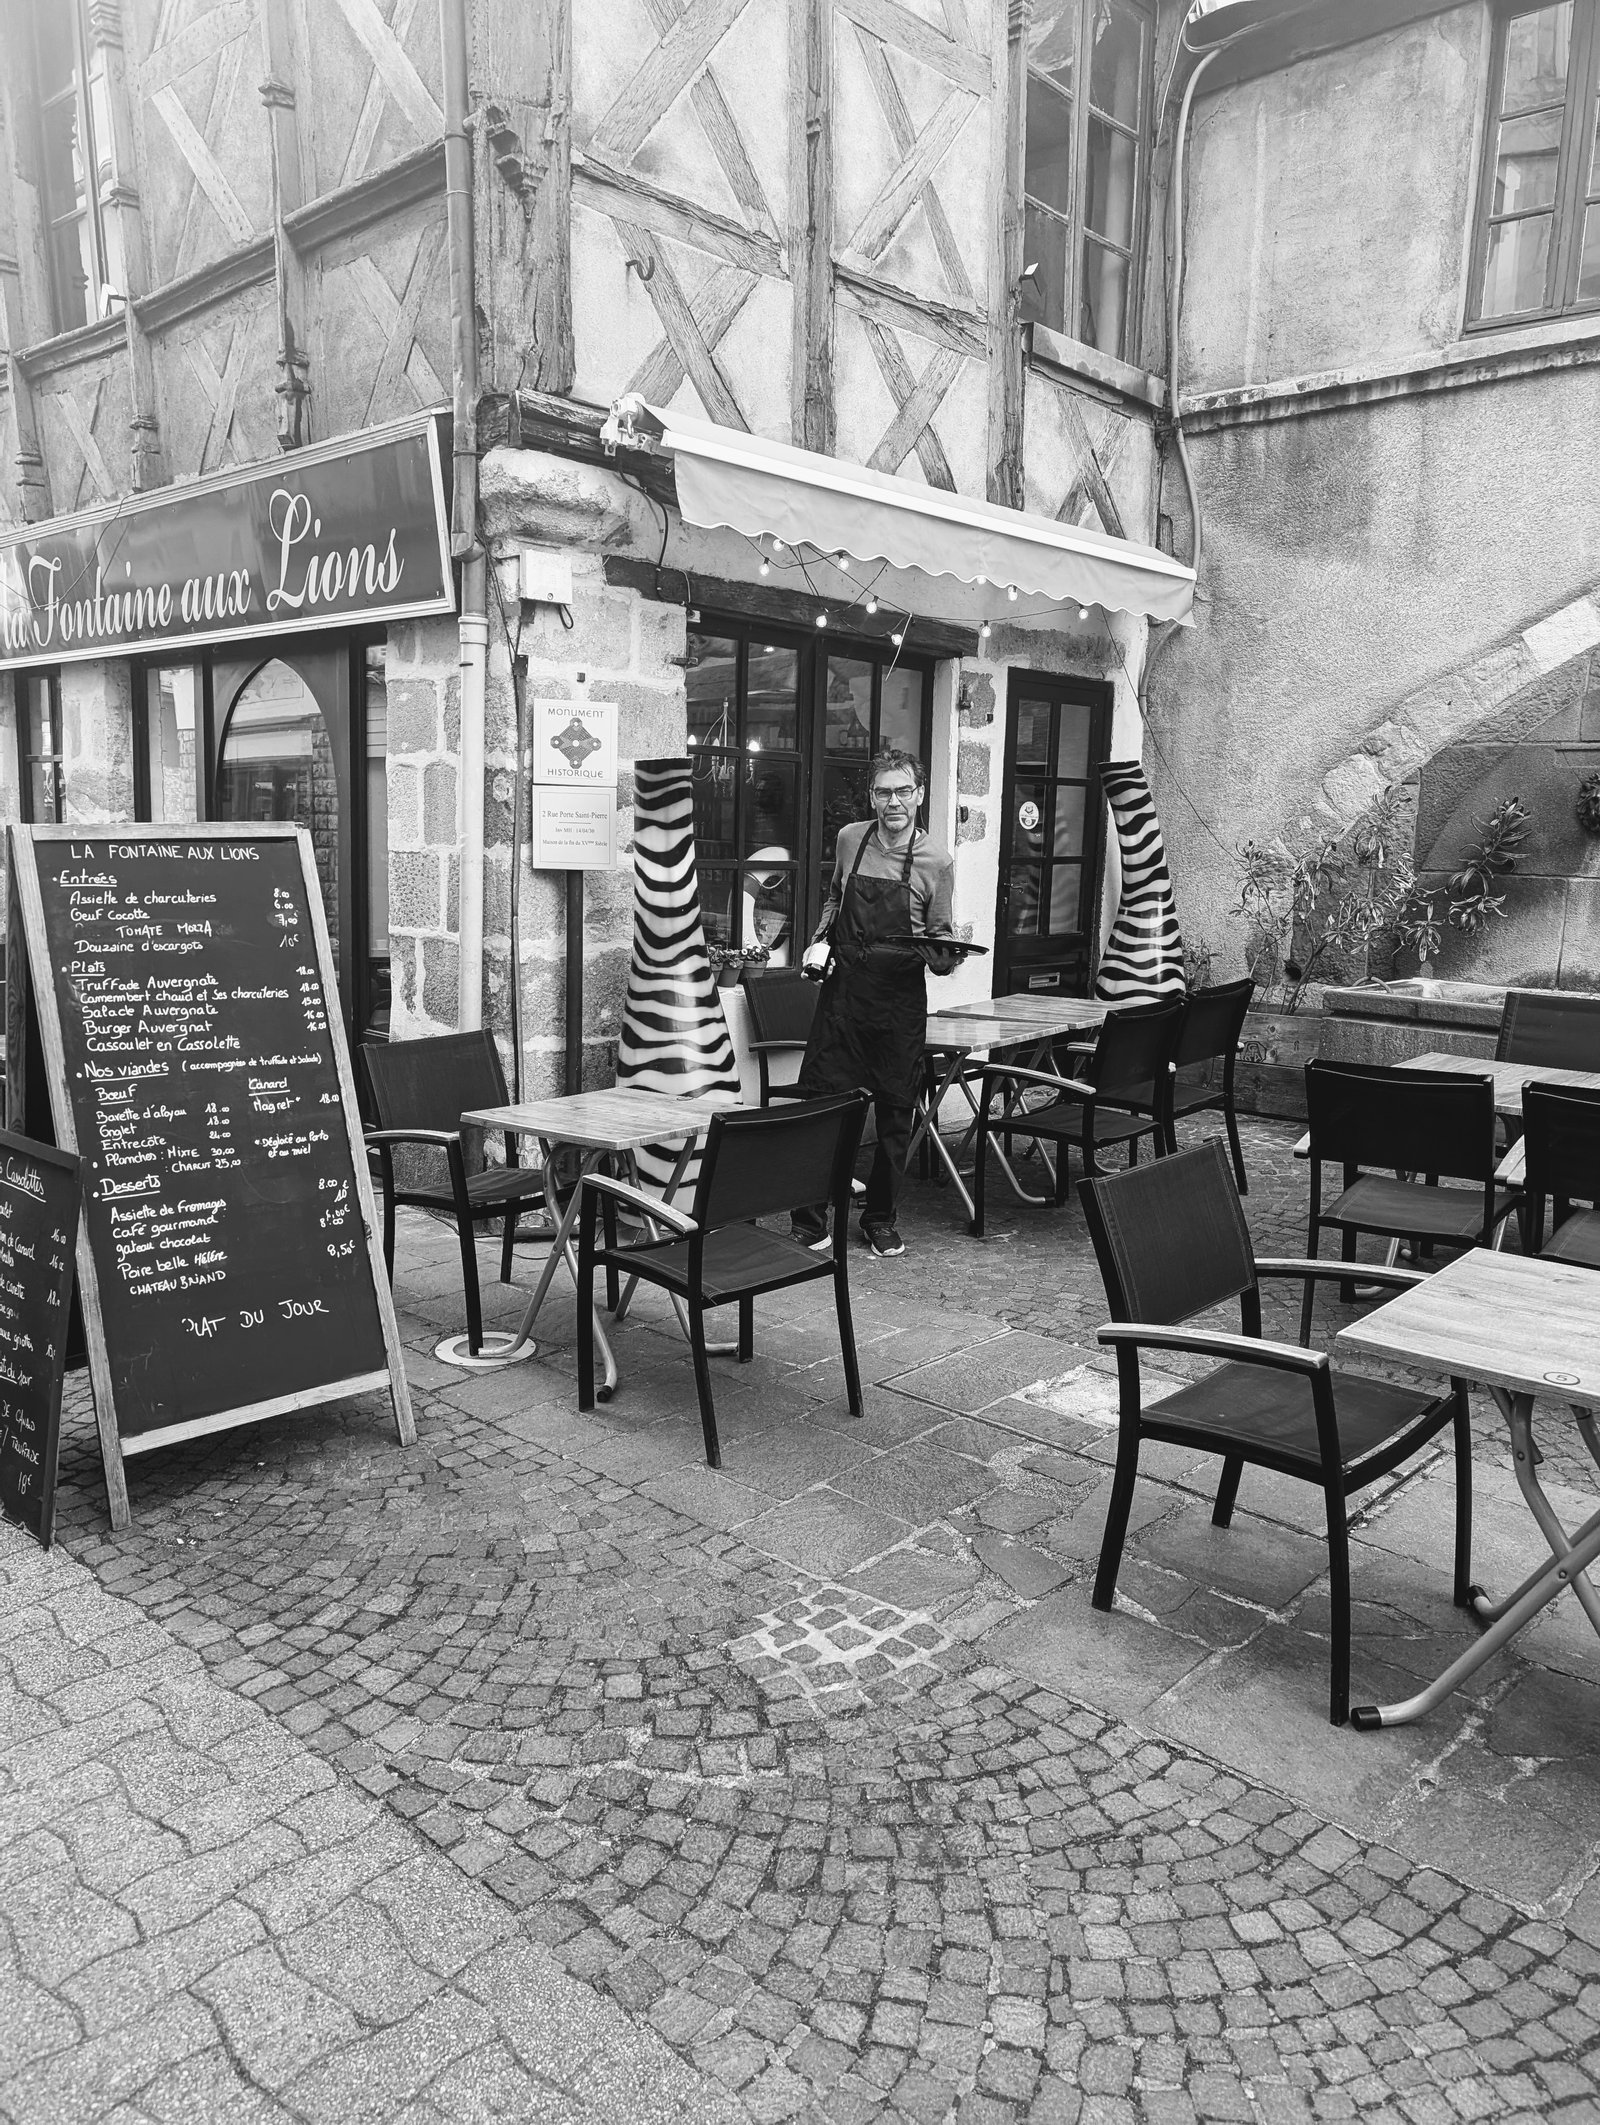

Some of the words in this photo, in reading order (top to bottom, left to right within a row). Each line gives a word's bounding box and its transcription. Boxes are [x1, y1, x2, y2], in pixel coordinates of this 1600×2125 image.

[29, 555, 172, 646] Fontaine
[181, 568, 251, 624] aux
[266, 488, 404, 612] Lions
[548, 708, 605, 719] MONUMENT
[547, 768, 604, 778] HISTORIQUE
[547, 810, 558, 818] Rue
[71, 844, 95, 859] LA
[109, 844, 183, 859] FONTAINE
[188, 846, 215, 860] AUX
[221, 845, 260, 860] LIONS
[69, 890, 118, 905] Assiette
[125, 892, 139, 904] de
[144, 889, 217, 904] charcuteries
[115, 925, 163, 938] TOMATE
[74, 940, 134, 953] Douzaine
[141, 939, 204, 954] d'escargots
[71, 960, 106, 974] Plats
[147, 973, 219, 993] Auvergnate
[156, 988, 193, 1001] chaud
[196, 990, 207, 1001] et
[231, 986, 289, 999] charcuteries
[82, 1006, 135, 1019] Salade
[143, 1005, 219, 1021] Auvergnate
[83, 1021, 132, 1039] Burger
[138, 1020, 213, 1038] Auvergnat
[86, 1038, 154, 1052] Cassoulet
[157, 1041, 172, 1052] en
[177, 1034, 241, 1051] Cassolette
[84, 1062, 114, 1079] Nos
[117, 1060, 169, 1076] viandes
[248, 1058, 257, 1067] de
[295, 1135, 307, 1143] au
[292, 1143, 311, 1156] miel
[99, 1174, 161, 1196] Desserts
[111, 1203, 158, 1225] Assiette
[160, 1203, 175, 1216] de
[150, 1214, 219, 1239] gourmand
[159, 1232, 211, 1249] chocolat
[117, 1262, 154, 1281] Poire
[156, 1255, 189, 1272] belle
[130, 1279, 177, 1295] CHATEAU
[239, 1309, 264, 1328] DU
[278, 1299, 330, 1320] JOUR
